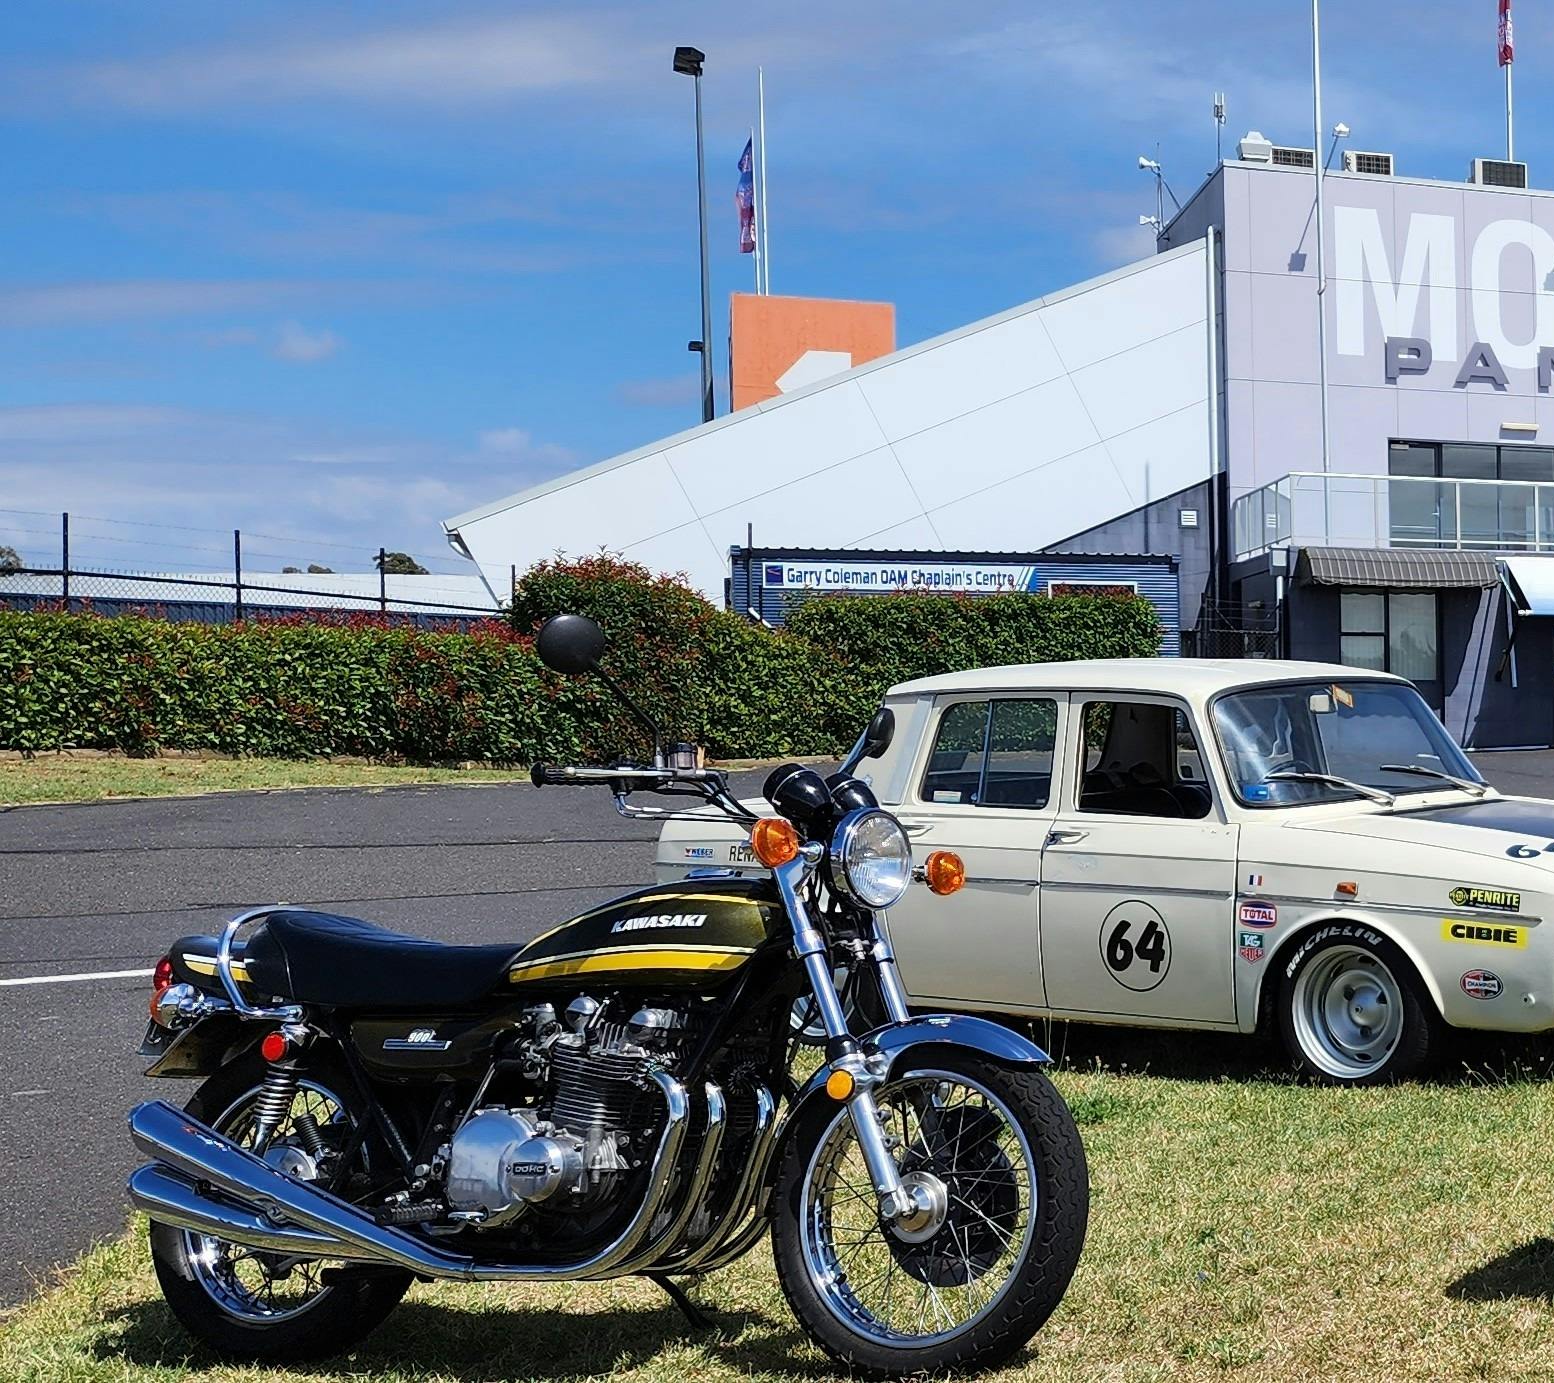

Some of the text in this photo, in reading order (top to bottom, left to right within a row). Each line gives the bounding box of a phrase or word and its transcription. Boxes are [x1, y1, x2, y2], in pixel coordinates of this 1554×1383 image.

[787, 568, 1015, 588] Garry Coleman OAM Chaplain's Centre
[1469, 889, 1520, 907] PENRITE
[611, 914, 708, 933] KAWASAKI
[1243, 909, 1274, 920] TOTAL
[1106, 920, 1165, 973] 64
[1286, 926, 1383, 978] MICHELIN
